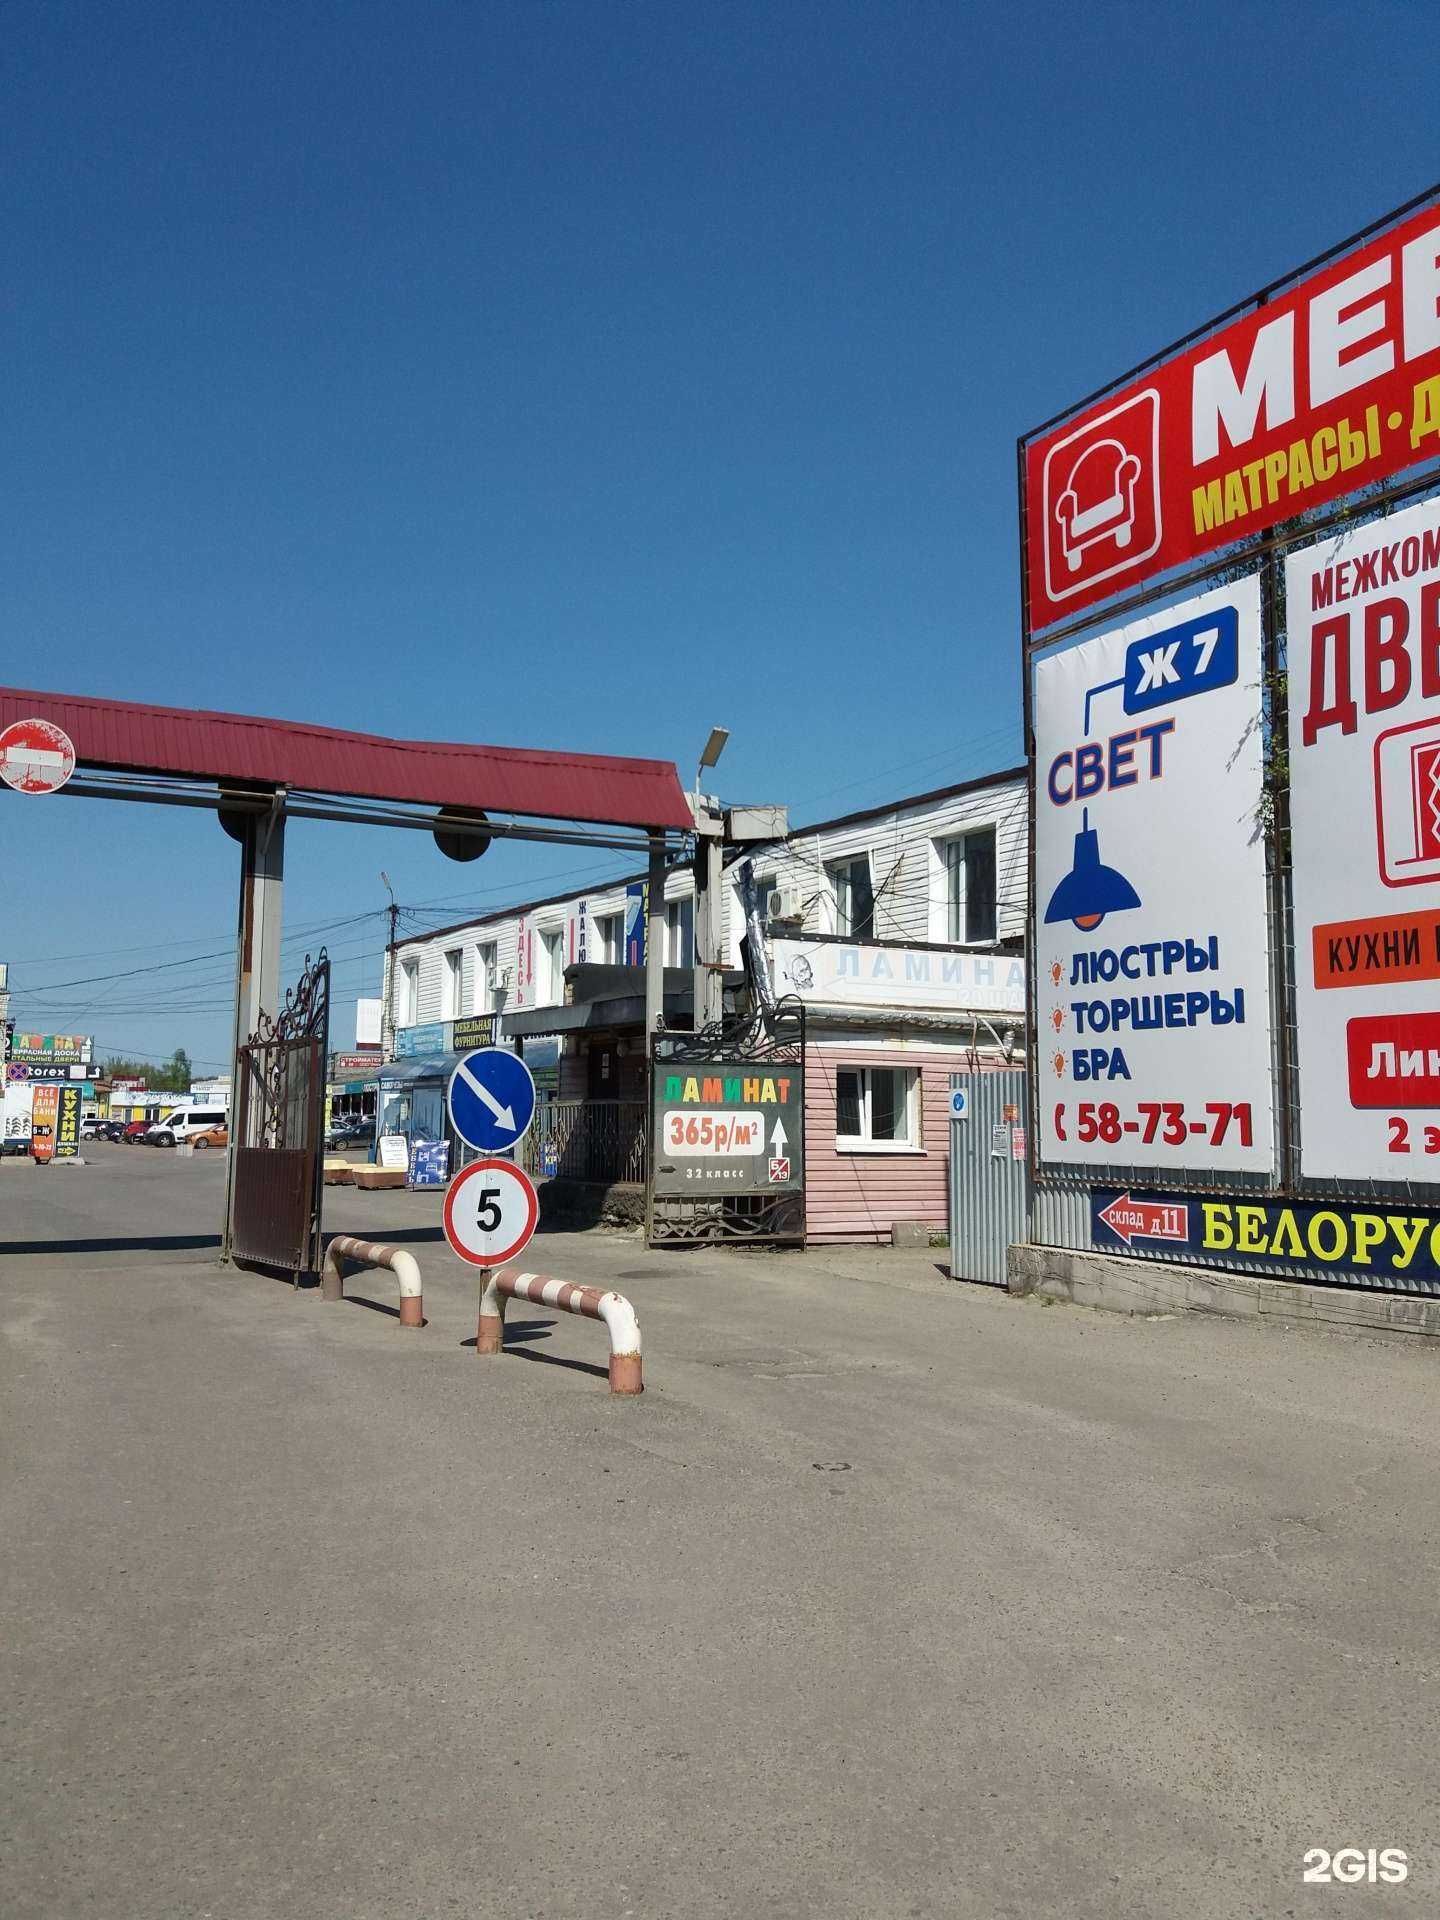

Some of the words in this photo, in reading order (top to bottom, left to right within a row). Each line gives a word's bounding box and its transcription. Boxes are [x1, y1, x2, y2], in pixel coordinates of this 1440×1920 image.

[1192, 404, 1381, 535] МАТРАСЫ
[1134, 639, 1181, 696] Ж
[1192, 627, 1219, 675] 7
[1047, 717, 1176, 807] СВЕТ
[517, 917, 525, 1004] ЗДЕСЬ
[1070, 935, 1219, 985] ЛЮСТРЫ
[1328, 927, 1420, 974] КУХНИ
[454, 1018, 492, 1034] МЕБЕЛЬНАЯ
[1071, 988, 1245, 1034] ТОРШЕРЫ
[454, 1033, 492, 1048] ФУРНИТУРА
[1072, 1047, 1132, 1081] БРА
[38, 1089, 54, 1097] ВСЕ
[664, 1076, 790, 1104] ЛАМИНАТ
[61, 1089, 77, 1141] КУХНИ
[1078, 1102, 1253, 1147] 58-73-71
[1387, 1116, 1411, 1154] 2
[686, 1169, 702, 1179] 32
[706, 1170, 744, 1179] класс
[477, 1189, 502, 1232] 5
